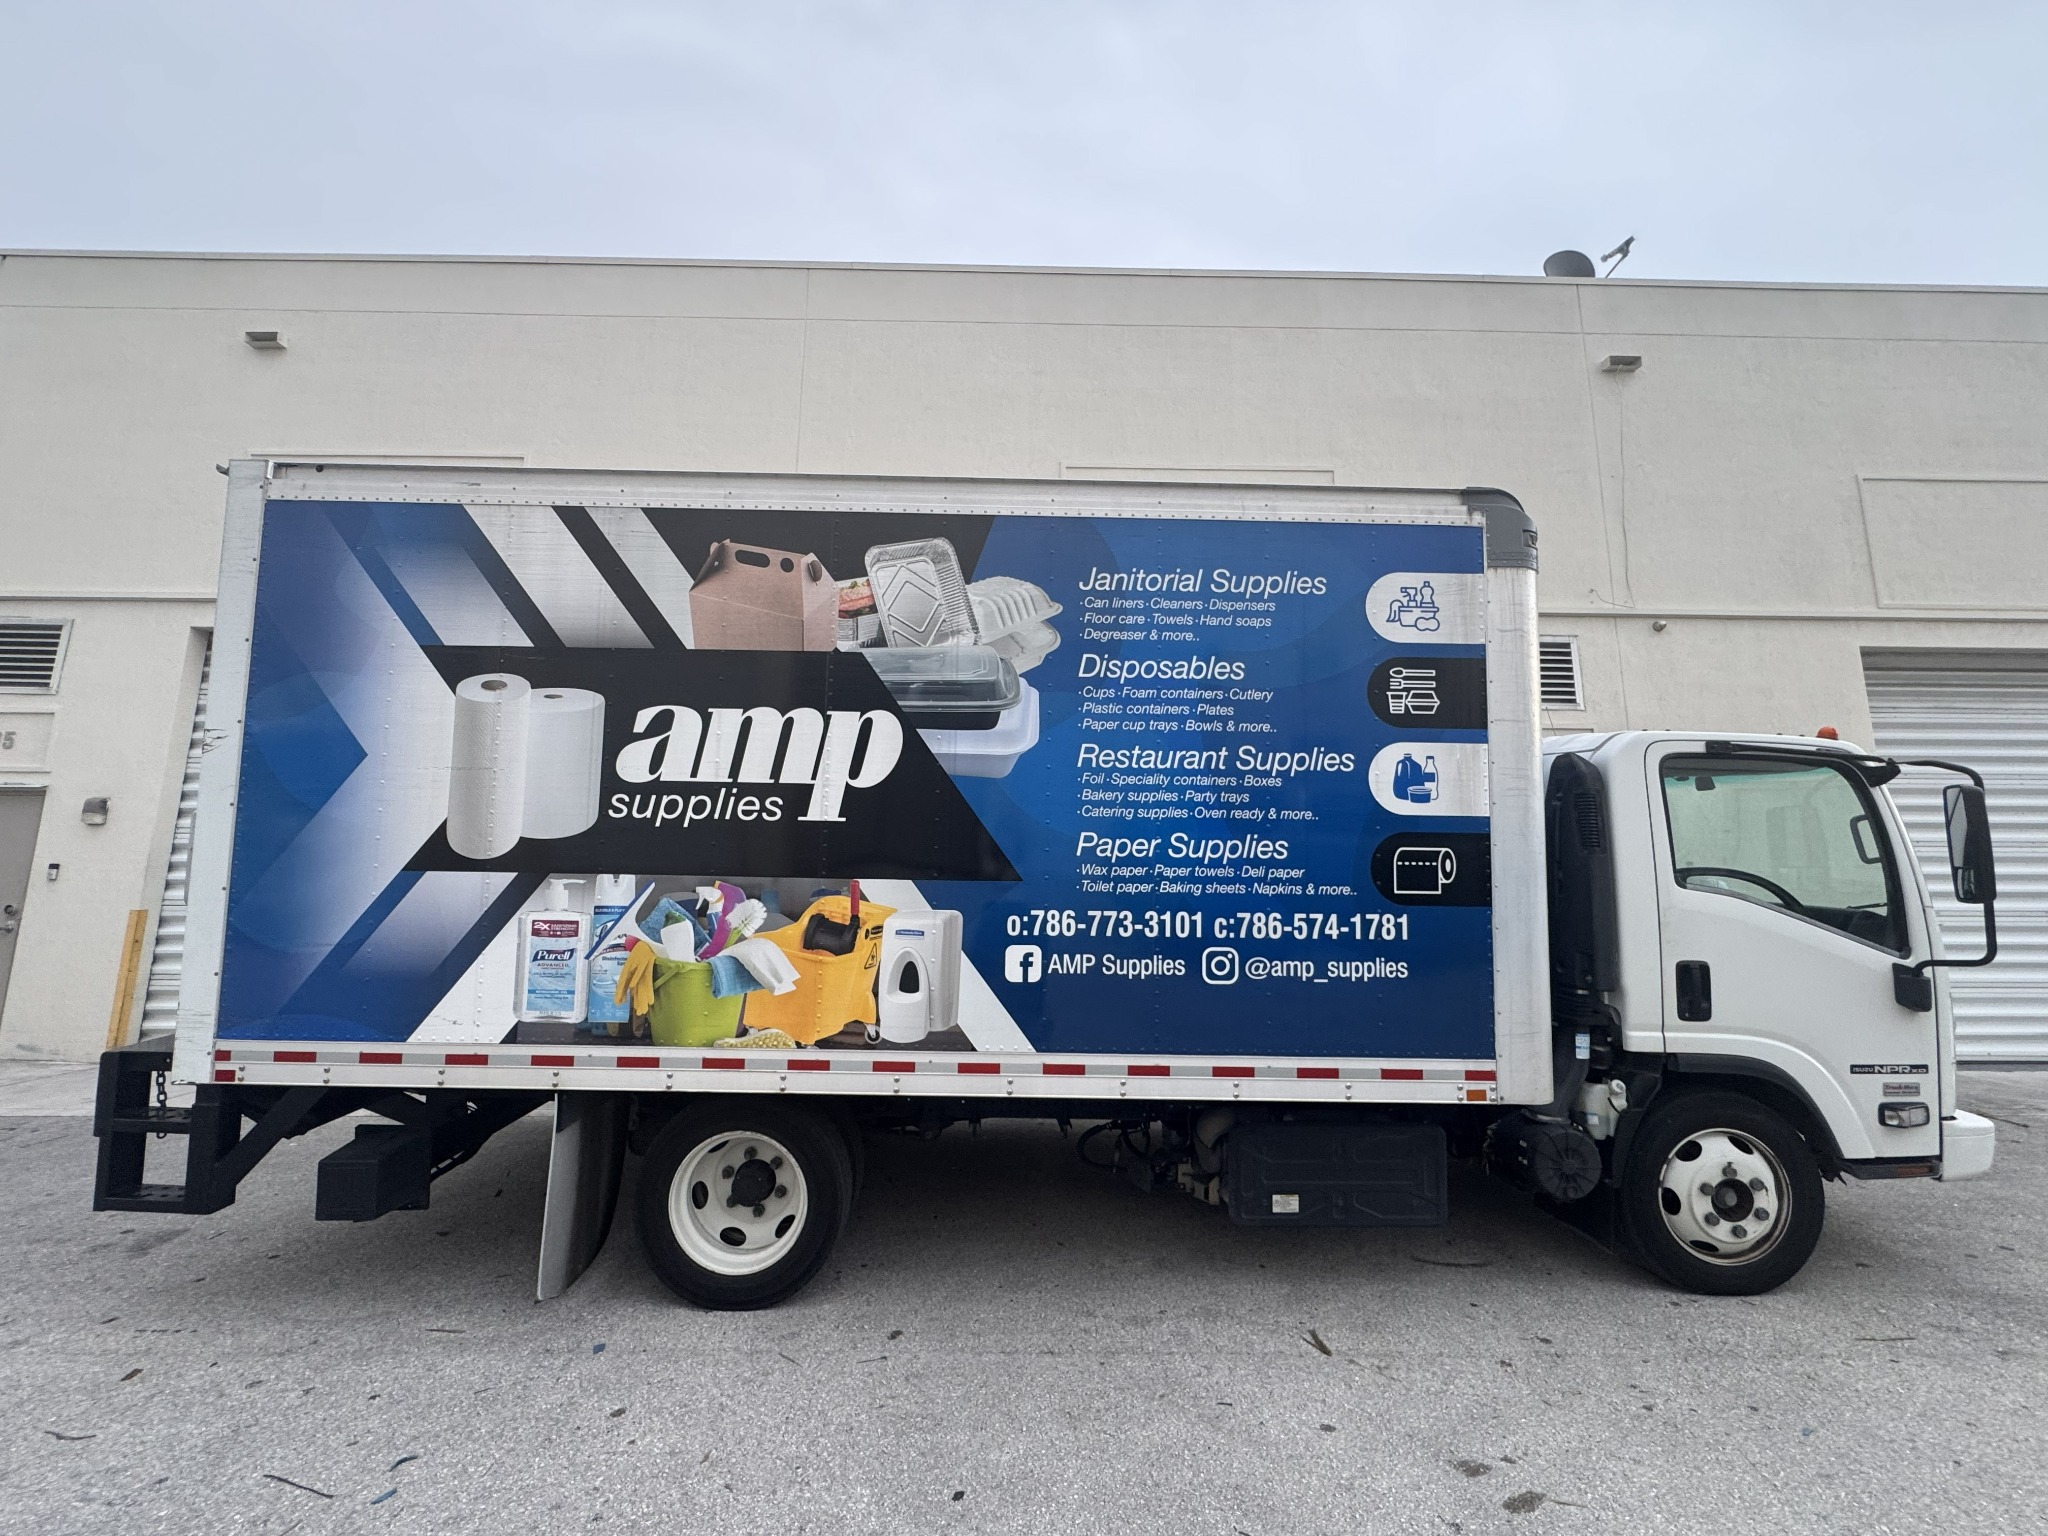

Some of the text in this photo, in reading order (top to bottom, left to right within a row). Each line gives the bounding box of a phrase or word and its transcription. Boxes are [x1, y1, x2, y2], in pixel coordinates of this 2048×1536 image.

[1079, 567, 1327, 599] Janitorial Supplies
[1084, 596, 1276, 614] Can liners Cleaners Dispensers
[1084, 612, 1272, 629] Floor care Towels Hand soaps
[1083, 628, 1146, 643] Degreaser
[1149, 628, 1159, 641] &
[1078, 653, 1245, 684] Disposables
[1083, 685, 1273, 703] Cups Foam containers Cutlery
[1082, 702, 1234, 716] Plastic containers Plates
[1082, 718, 1119, 733] Paper
[1122, 722, 1144, 733] cup
[1149, 719, 1179, 733] trays
[1185, 718, 1223, 732] Bowls
[1226, 719, 1236, 732] &
[0, 731, 16, 749] 5
[615, 704, 904, 822] amp
[1077, 743, 1355, 777] Restaurant Supplies
[1082, 772, 1282, 788] Foil Speciality containers Boxes
[1082, 788, 1250, 804] Bakery supplies Party trays
[608, 787, 784, 828] supplies
[1081, 805, 1134, 820] Catering
[1137, 805, 1188, 821] supplies
[1194, 806, 1226, 819] Oven
[1229, 806, 1265, 822] ready
[1267, 807, 1278, 820] &
[1076, 831, 1288, 864] Paper Supplies
[1081, 864, 1306, 881] Wax paper Paper towels Deli paper
[1081, 879, 1114, 892] Toilet
[1117, 882, 1154, 895] paper
[1159, 880, 1202, 896] Baking
[1205, 881, 1246, 894] sheets
[1252, 881, 1302, 897] Napkins
[1305, 882, 1316, 895] &
[1006, 909, 1409, 941] o:786-773-3101 c:786-574-1781
[1048, 953, 1096, 975] AMP
[1102, 954, 1185, 979] Supplies
[1245, 956, 1409, 983] @amp_supplies
[1874, 1065, 1911, 1074] NPR
